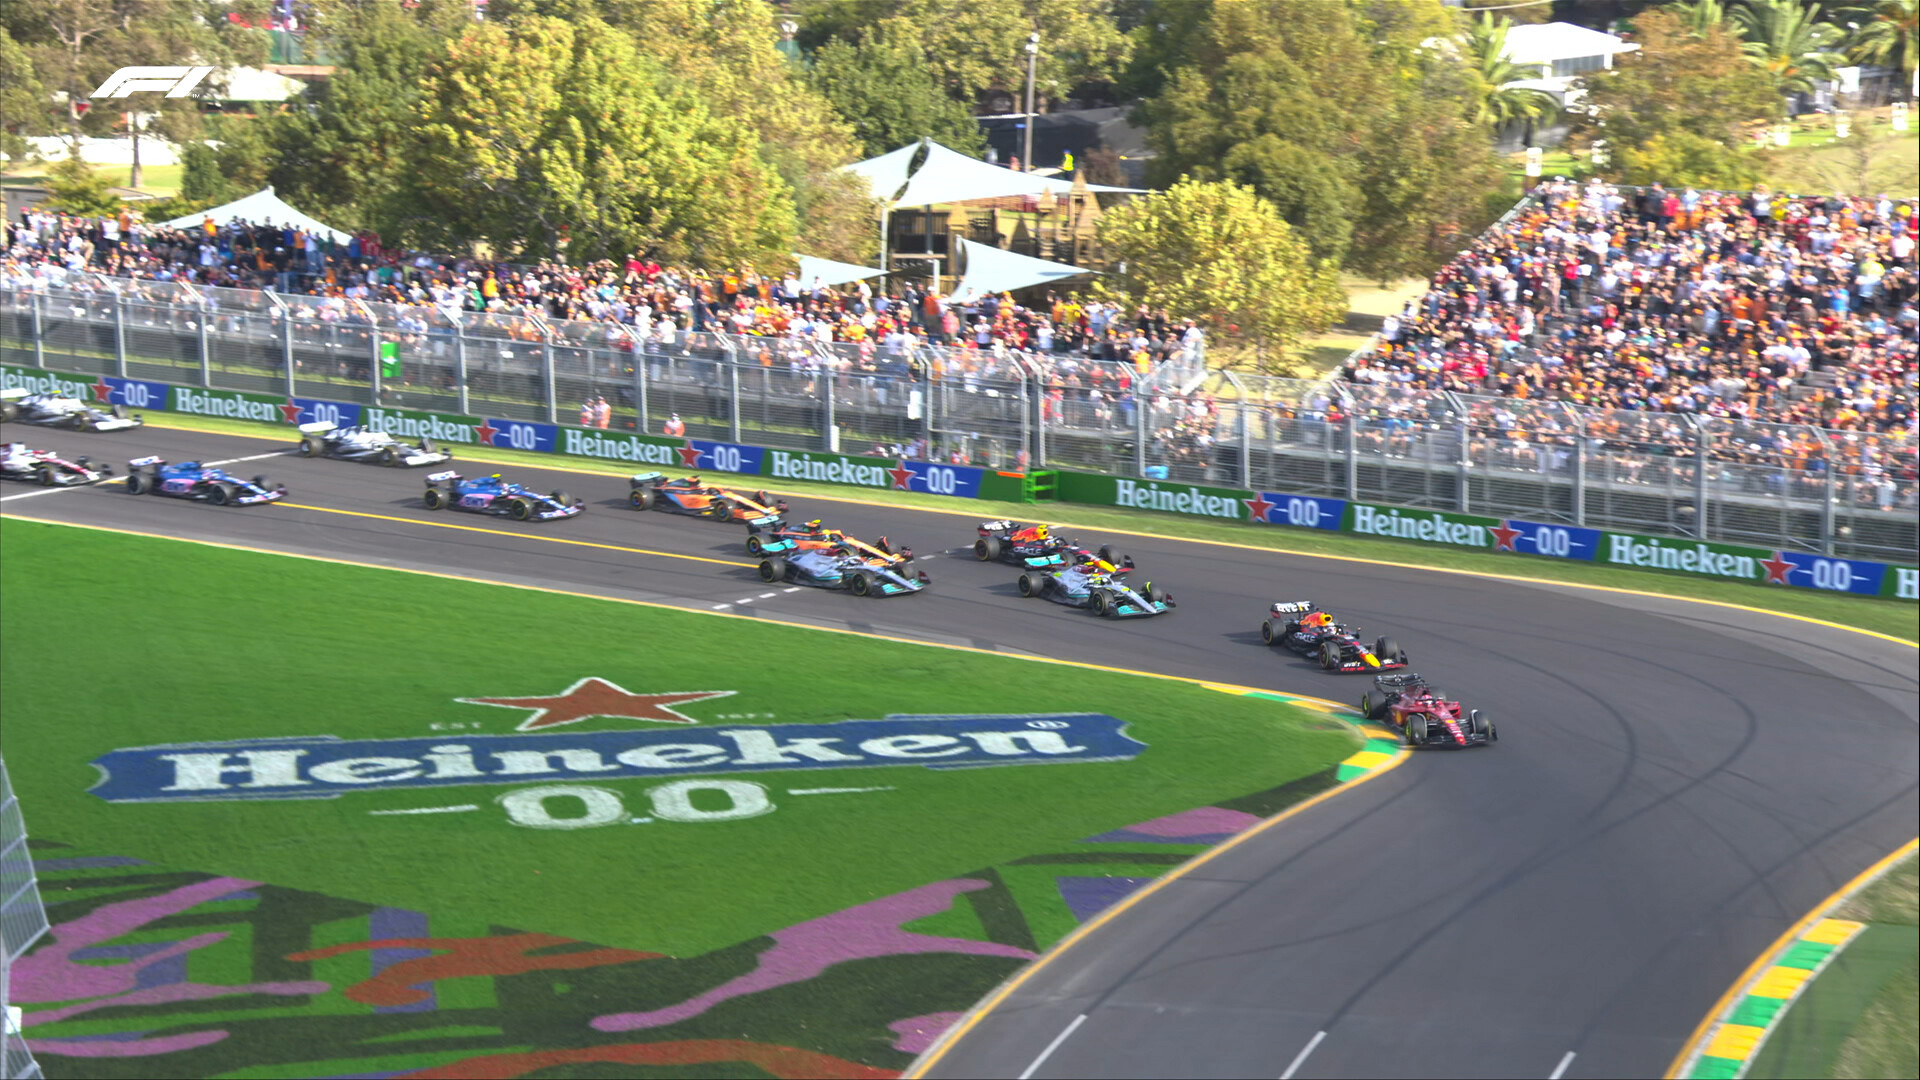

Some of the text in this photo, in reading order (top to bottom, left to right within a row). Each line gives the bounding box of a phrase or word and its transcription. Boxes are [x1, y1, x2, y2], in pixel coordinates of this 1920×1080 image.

[175, 388, 276, 421] Heineken
[367, 408, 472, 443] Heineken
[565, 429, 674, 465] Heineken
[771, 451, 887, 487] Heineken
[1116, 479, 1240, 519] Heineken
[1353, 505, 1488, 547] Heineken
[1609, 534, 1757, 579] Heineken
[159, 729, 1088, 791] Heineken
